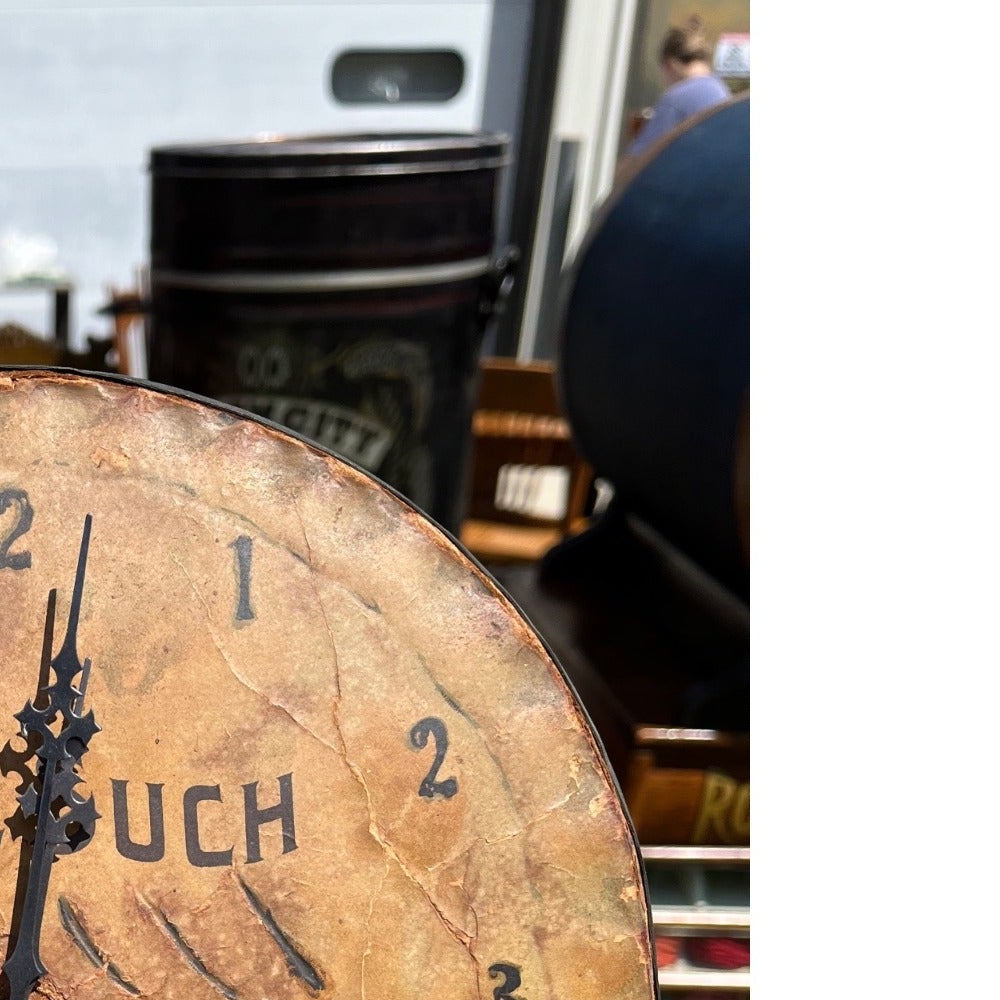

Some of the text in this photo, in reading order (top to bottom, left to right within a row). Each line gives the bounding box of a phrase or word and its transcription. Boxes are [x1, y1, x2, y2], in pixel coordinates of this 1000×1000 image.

[229, 533, 259, 625] 1
[408, 715, 459, 800] 2
[42, 771, 299, 869] UCH
